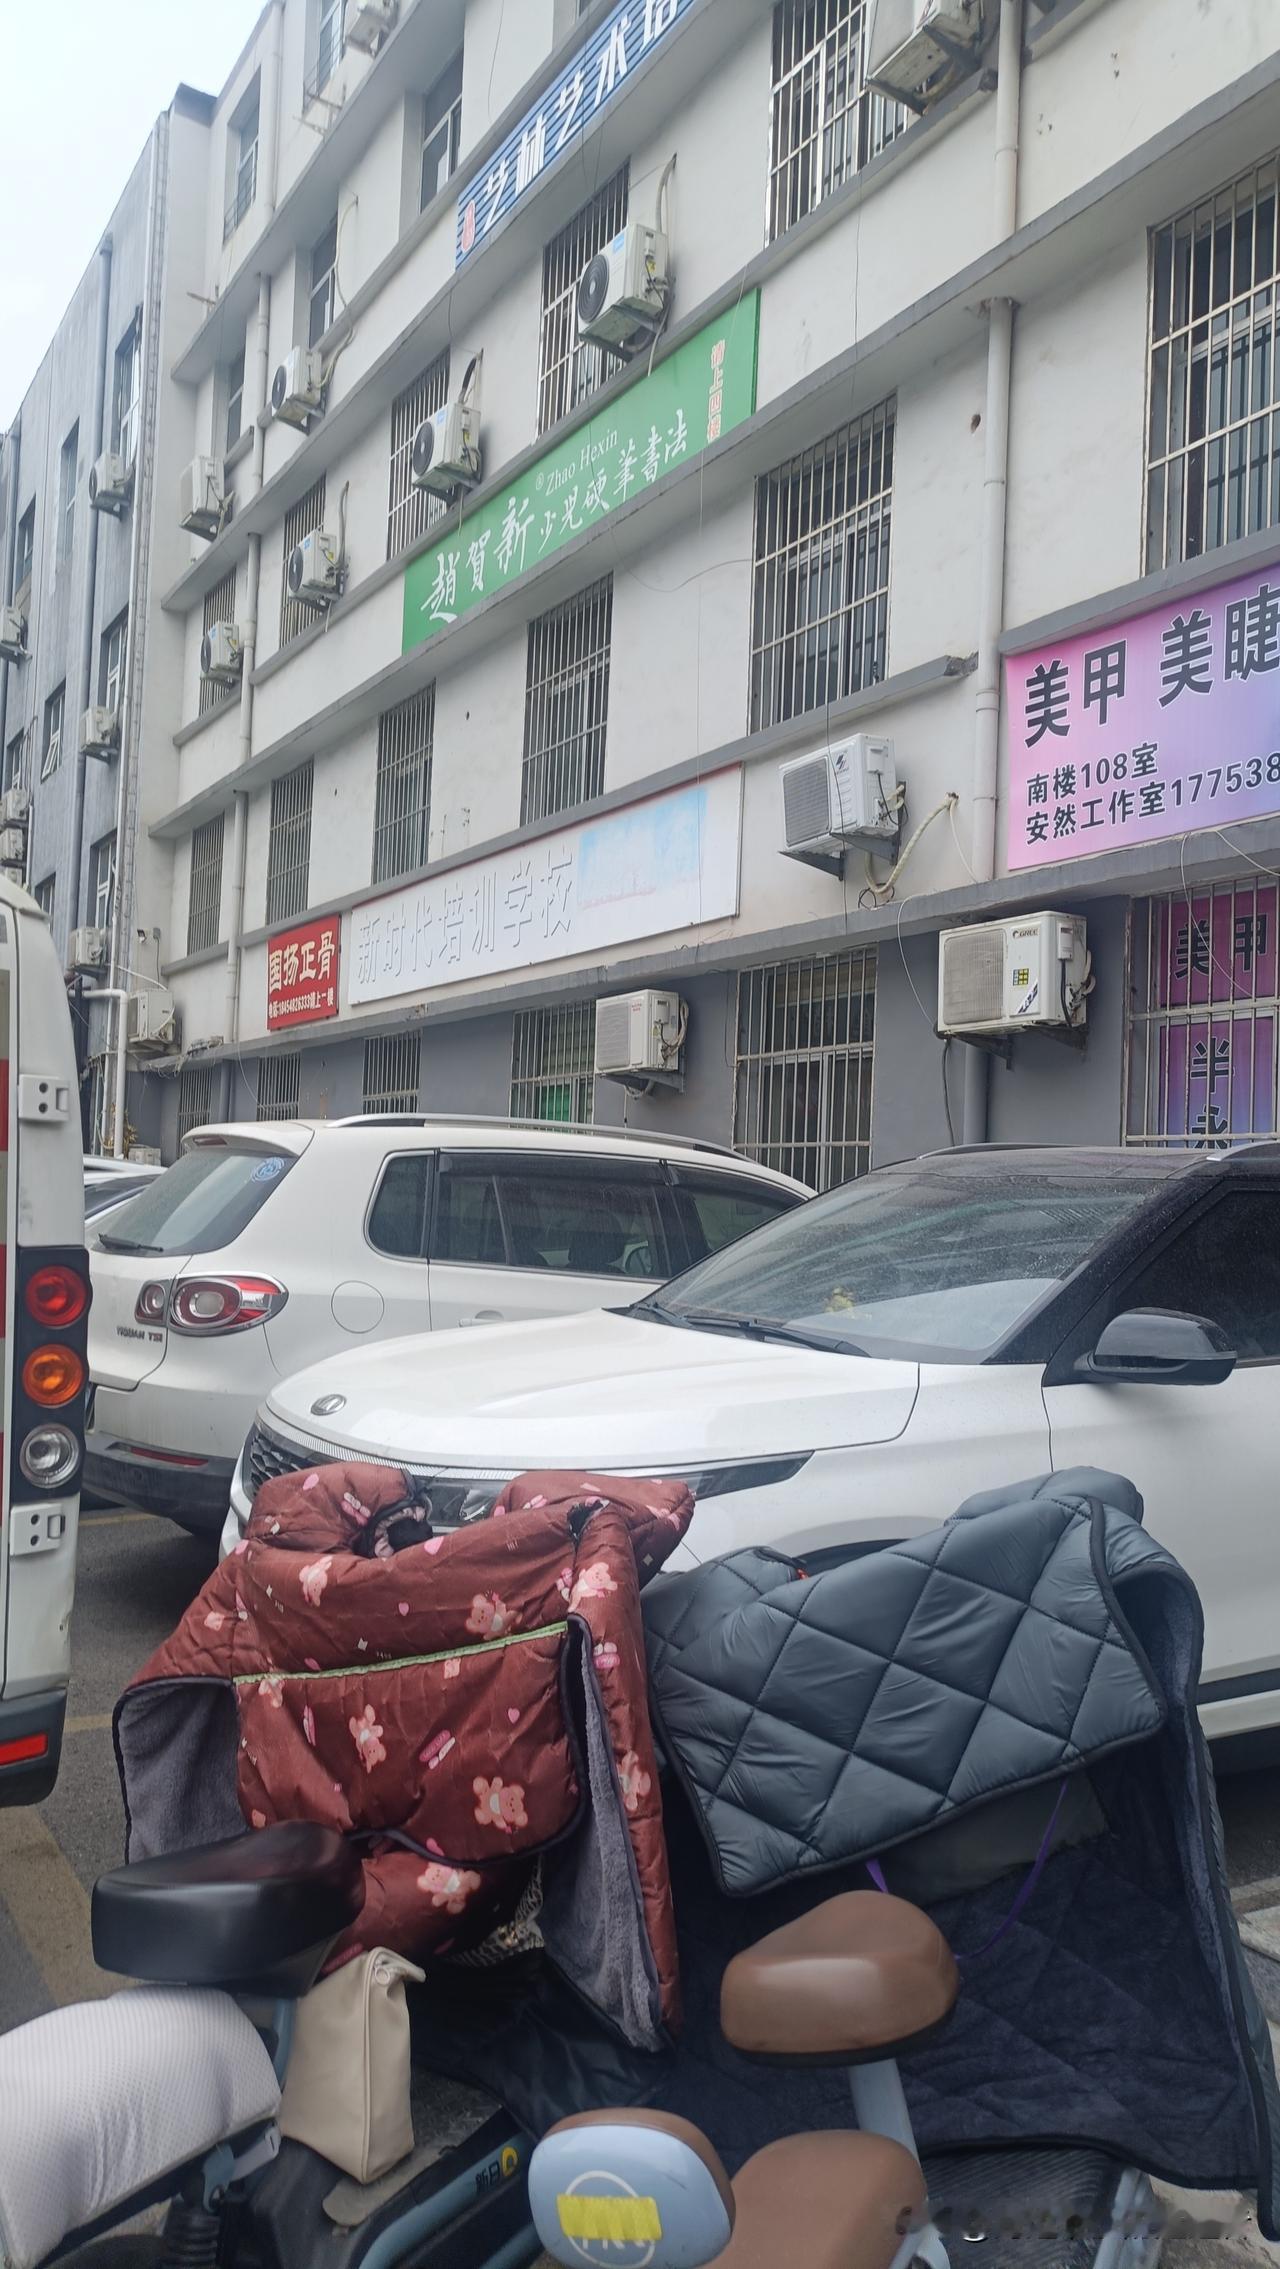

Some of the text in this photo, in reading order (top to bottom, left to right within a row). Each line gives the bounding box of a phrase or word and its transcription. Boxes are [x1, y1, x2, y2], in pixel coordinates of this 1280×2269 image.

[545, 428, 617, 496] Zhao Hexin
[1024, 584, 1280, 748] 美甲 美睫
[1026, 742, 1158, 807] 南楼108室
[357, 844, 573, 984] 新时代培训学校
[1175, 914, 1268, 979] 美甲
